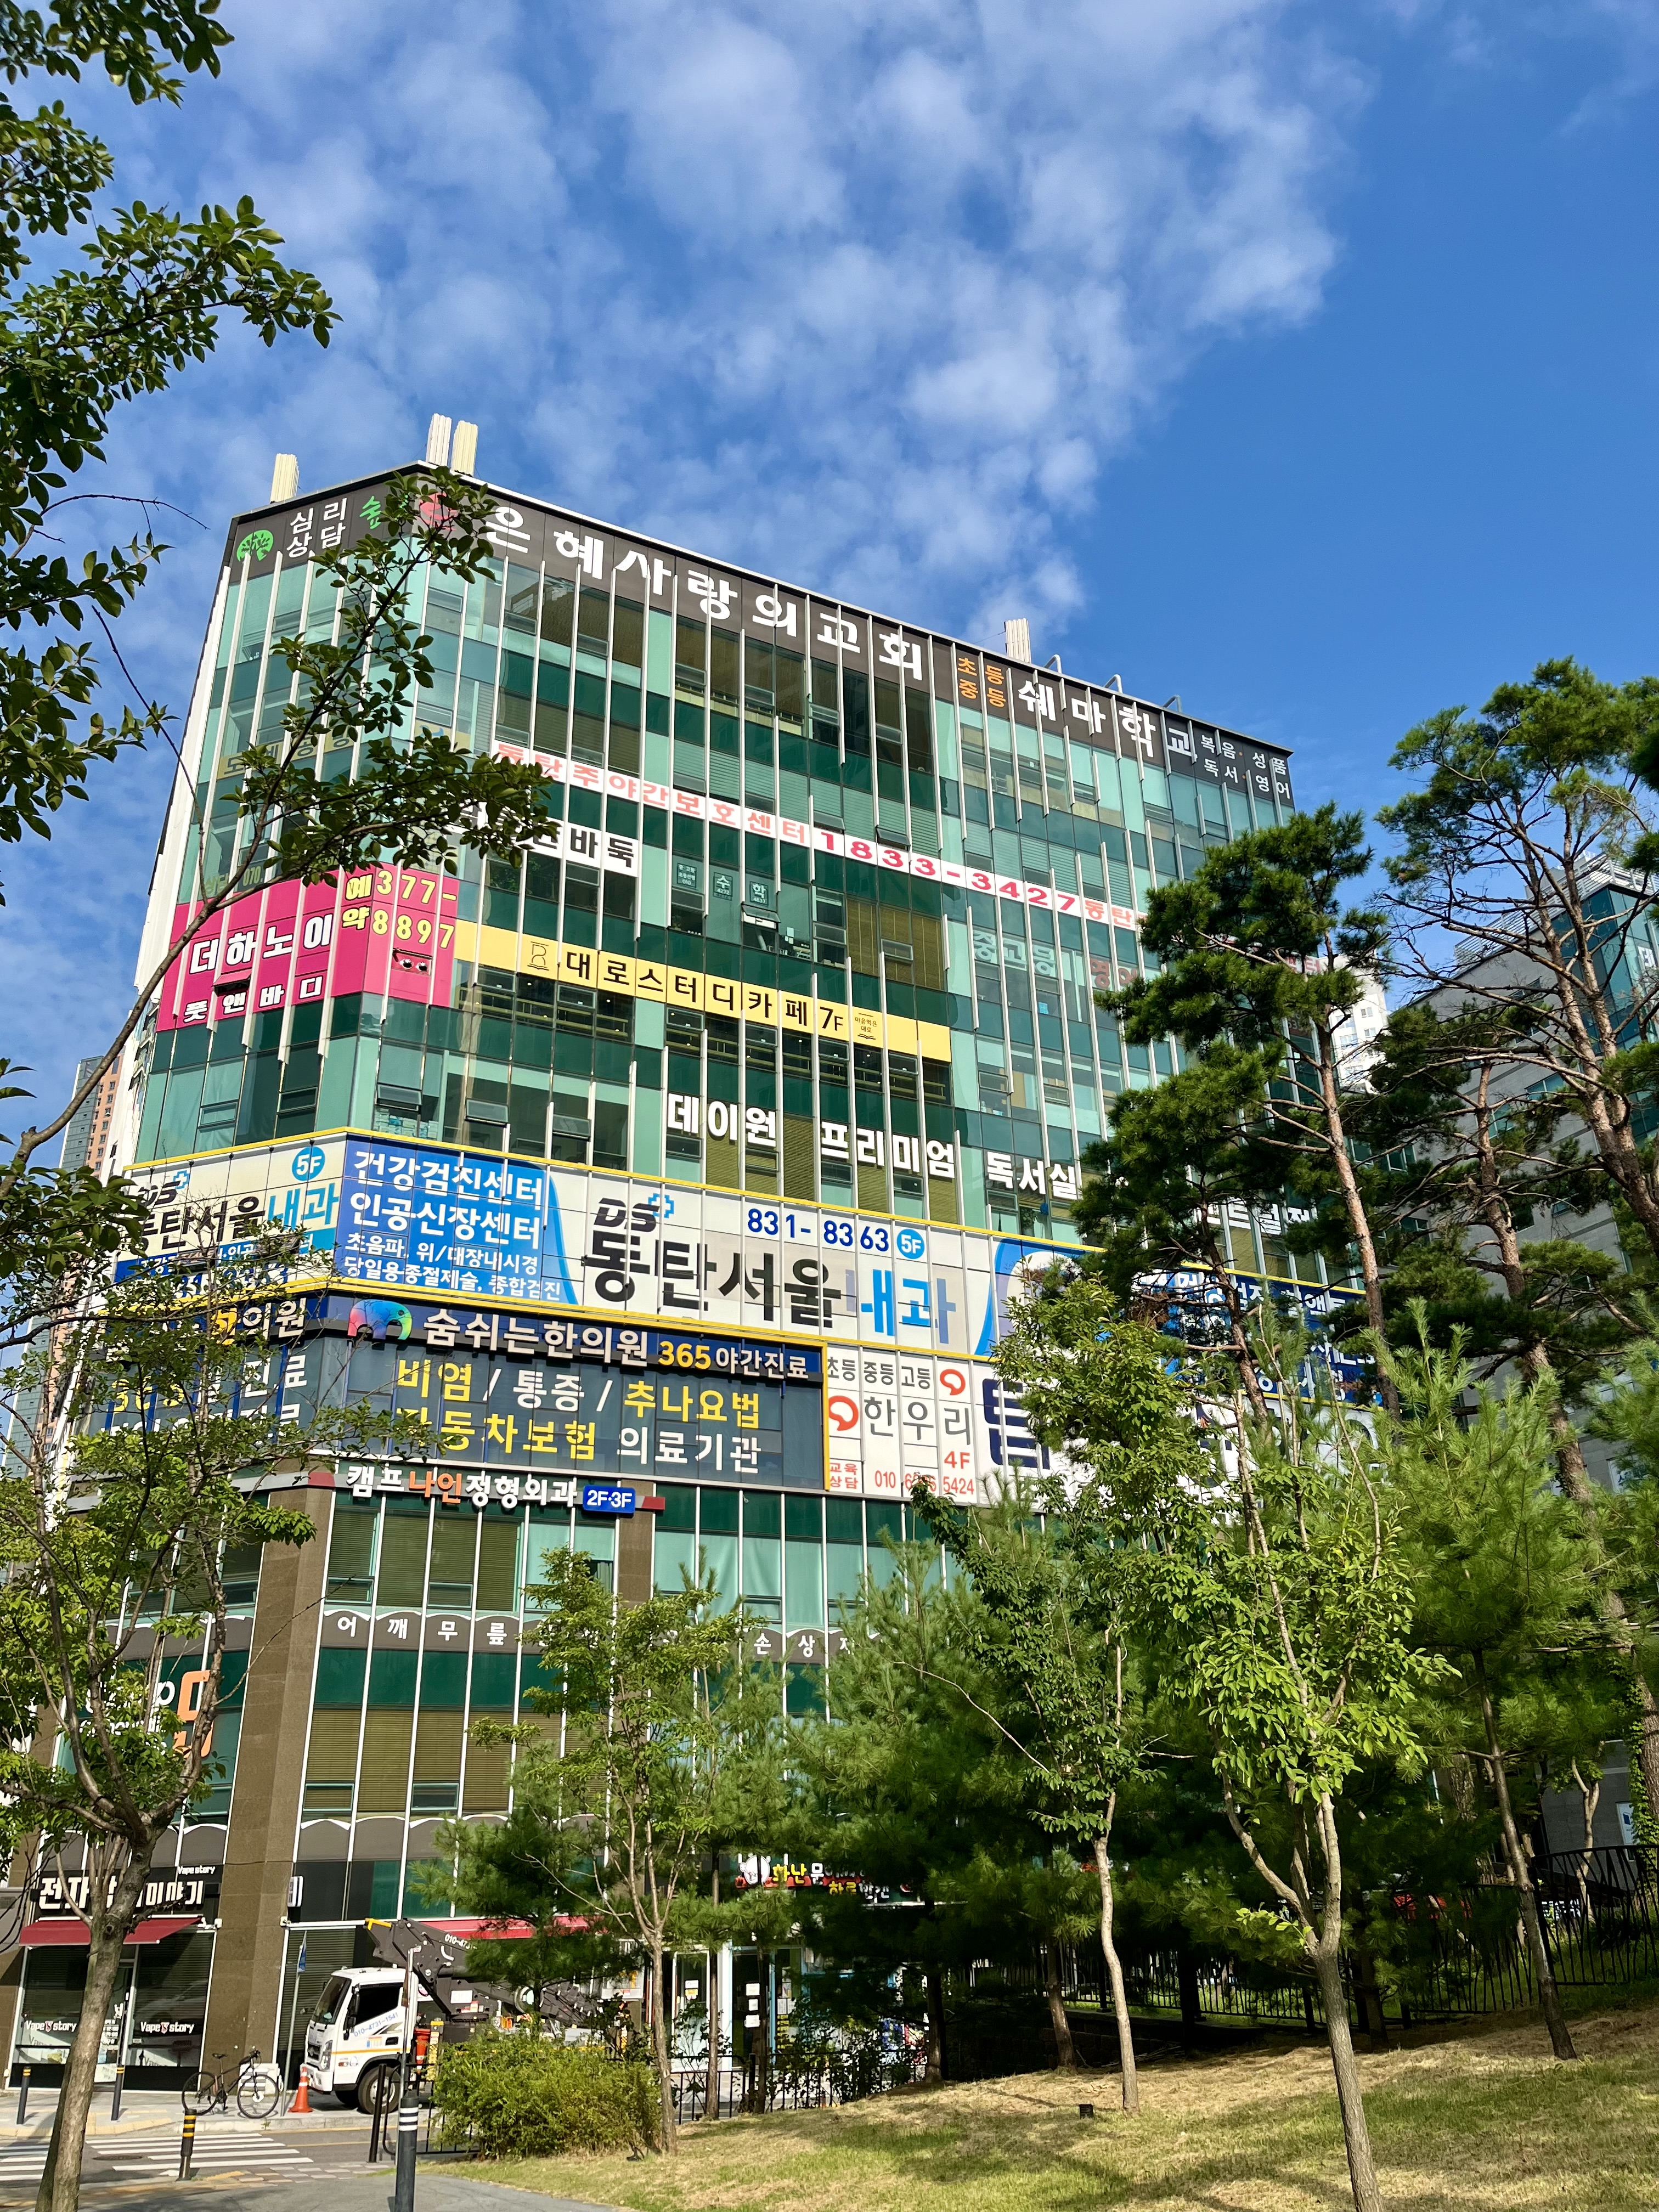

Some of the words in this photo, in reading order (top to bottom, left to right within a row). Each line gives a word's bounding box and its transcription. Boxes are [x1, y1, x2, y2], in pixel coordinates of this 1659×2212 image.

[290, 498, 347, 534] 심리
[286, 525, 346, 557] 상담
[486, 506, 923, 681] 은혜사랑의교회
[958, 657, 1005, 685] 초등
[958, 679, 1006, 708] 중등
[1018, 680, 1198, 761] 쉐마학교
[821, 832, 1076, 911] 1833-3427
[189, 913, 332, 974] 더하노이
[373, 909, 454, 949] 8897
[183, 976, 323, 1023] 풋앤바디
[820, 1007, 844, 1031] 7F
[667, 1093, 776, 1147] 데이원
[821, 1121, 955, 1178] 프리미엄
[987, 1151, 1080, 1200] 독서실
[296, 1154, 321, 1176] 5F
[354, 1151, 542, 1210] 건강검진센터
[351, 1192, 540, 1250] 인공신장센터
[901, 1235, 922, 1254] 5F
[489, 1276, 561, 1301] 종합검진
[424, 1308, 648, 1367] 숨쉬는한의원
[658, 1340, 712, 1370] 365
[715, 1346, 809, 1380] 야간진료
[828, 1356, 856, 1381] 초등
[864, 1361, 894, 1386] 중등
[901, 1365, 931, 1390] 고등
[397, 1359, 472, 1402] 비염
[513, 1369, 585, 1412] 통증
[624, 1380, 759, 1429] 추나요법
[864, 1396, 971, 1445] 한우리
[617, 1426, 762, 1474] 의료기관
[944, 1451, 970, 1469] 4F
[830, 1462, 858, 1475] 교육
[830, 1476, 859, 1489] 상담
[874, 1470, 896, 1488] 010
[943, 1476, 974, 1495] 5424
[347, 1465, 578, 1509] 캠프나인정형외과
[39, 1876, 204, 1910] 전자이야기
[53, 2022, 77, 2032] story
[140, 2022, 160, 2033] Vape
[169, 2022, 194, 2034] story
